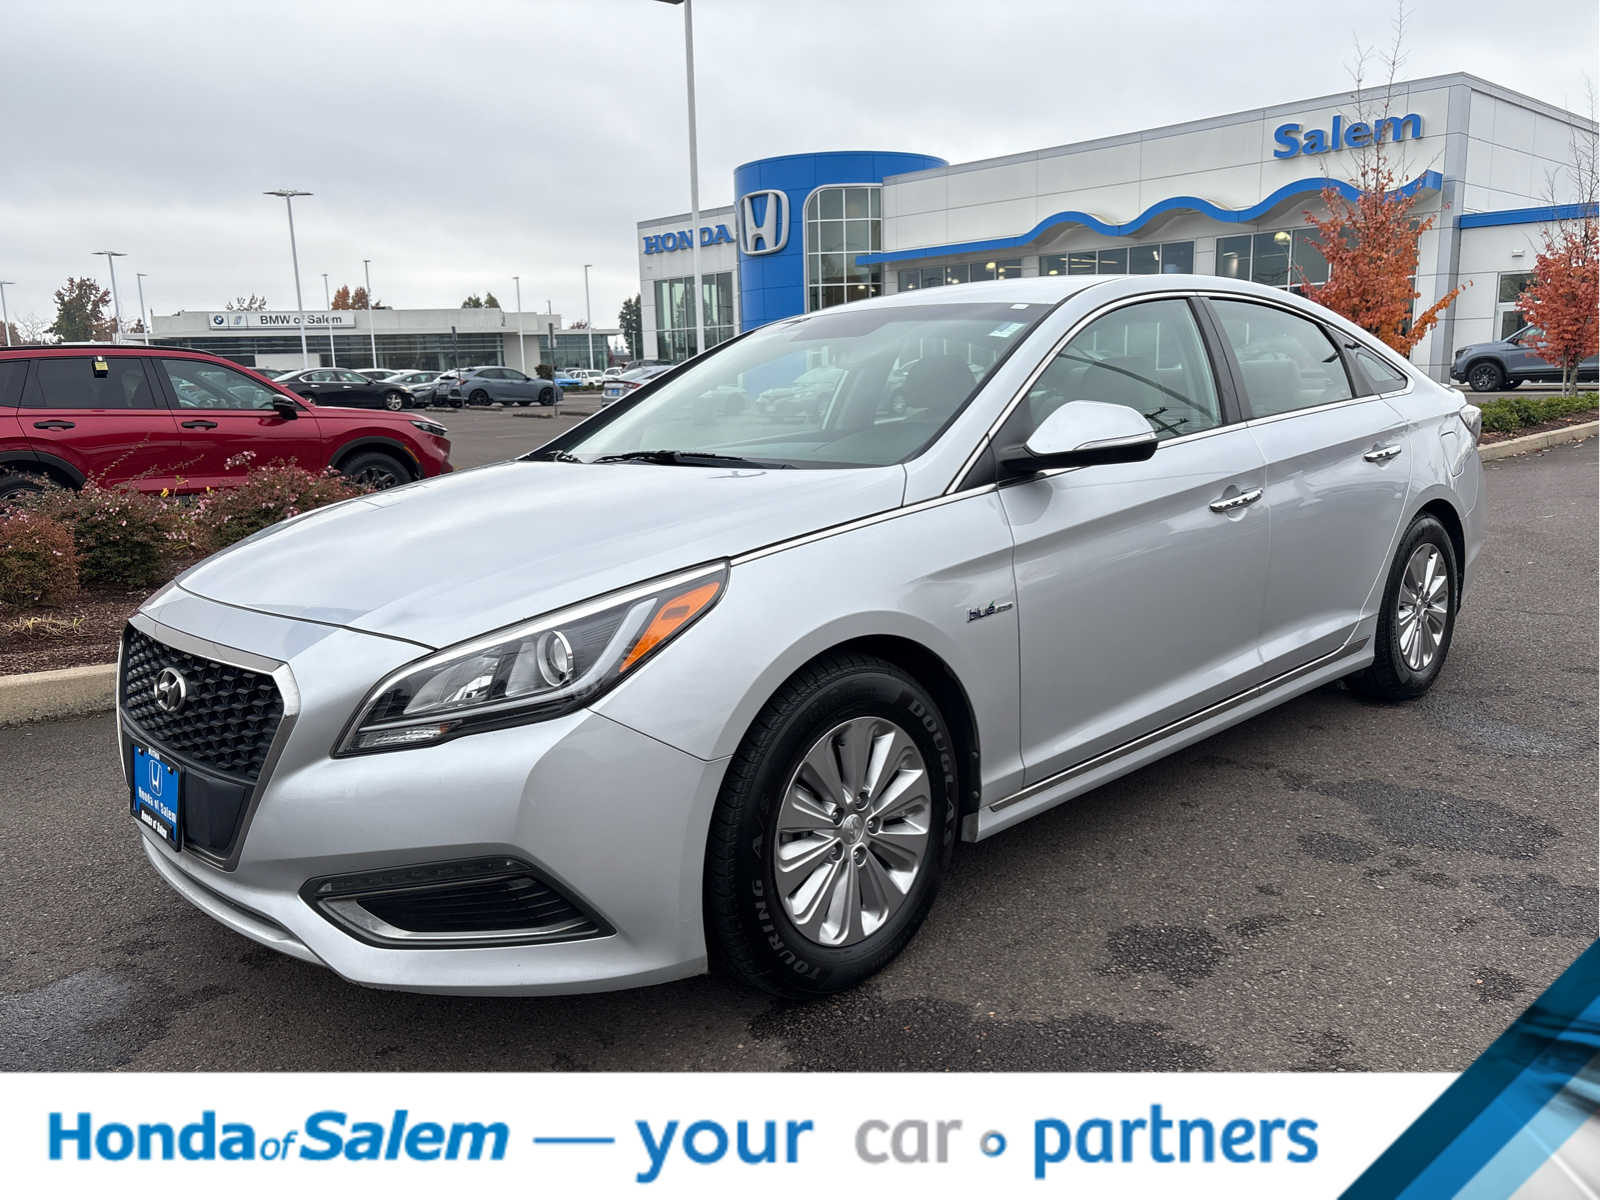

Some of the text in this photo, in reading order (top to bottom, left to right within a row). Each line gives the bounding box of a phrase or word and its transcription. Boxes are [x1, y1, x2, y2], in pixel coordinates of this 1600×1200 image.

[1273, 113, 1423, 159] Salem
[643, 224, 733, 255] HONDA
[260, 315, 290, 325] BMW
[752, 879, 821, 980] TOURING
